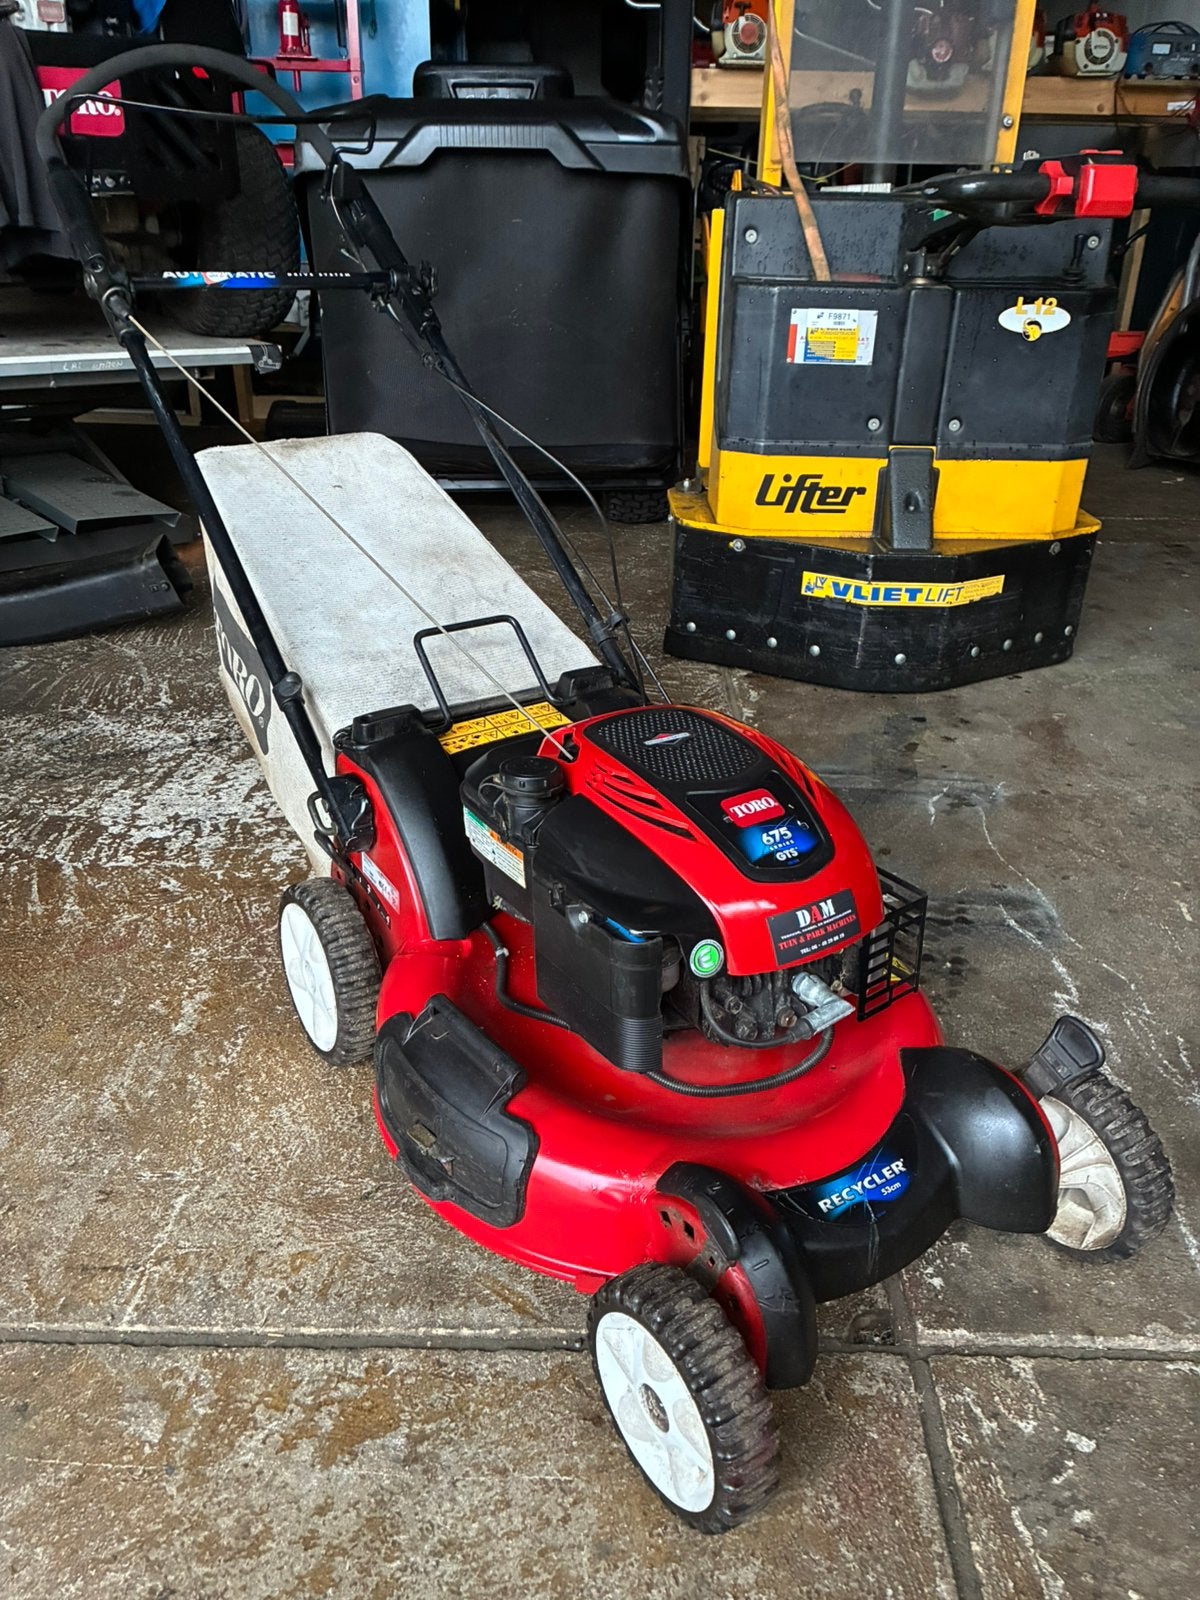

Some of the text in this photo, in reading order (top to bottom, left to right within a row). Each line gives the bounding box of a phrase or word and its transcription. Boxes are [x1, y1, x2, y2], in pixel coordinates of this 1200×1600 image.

[829, 312, 851, 320] F9871
[1015, 296, 1058, 315] L 12
[755, 473, 867, 514] Lifter
[729, 796, 776, 818] TORO
[762, 826, 793, 846] 675
[776, 848, 799, 861] GTS
[796, 898, 836, 928] DAM
[778, 939, 798, 950] TUIN
[806, 929, 826, 940] PARK
[826, 914, 857, 932] MACHINES
[818, 1159, 907, 1213] RECYCLER
[881, 1182, 902, 1196] 53cm
